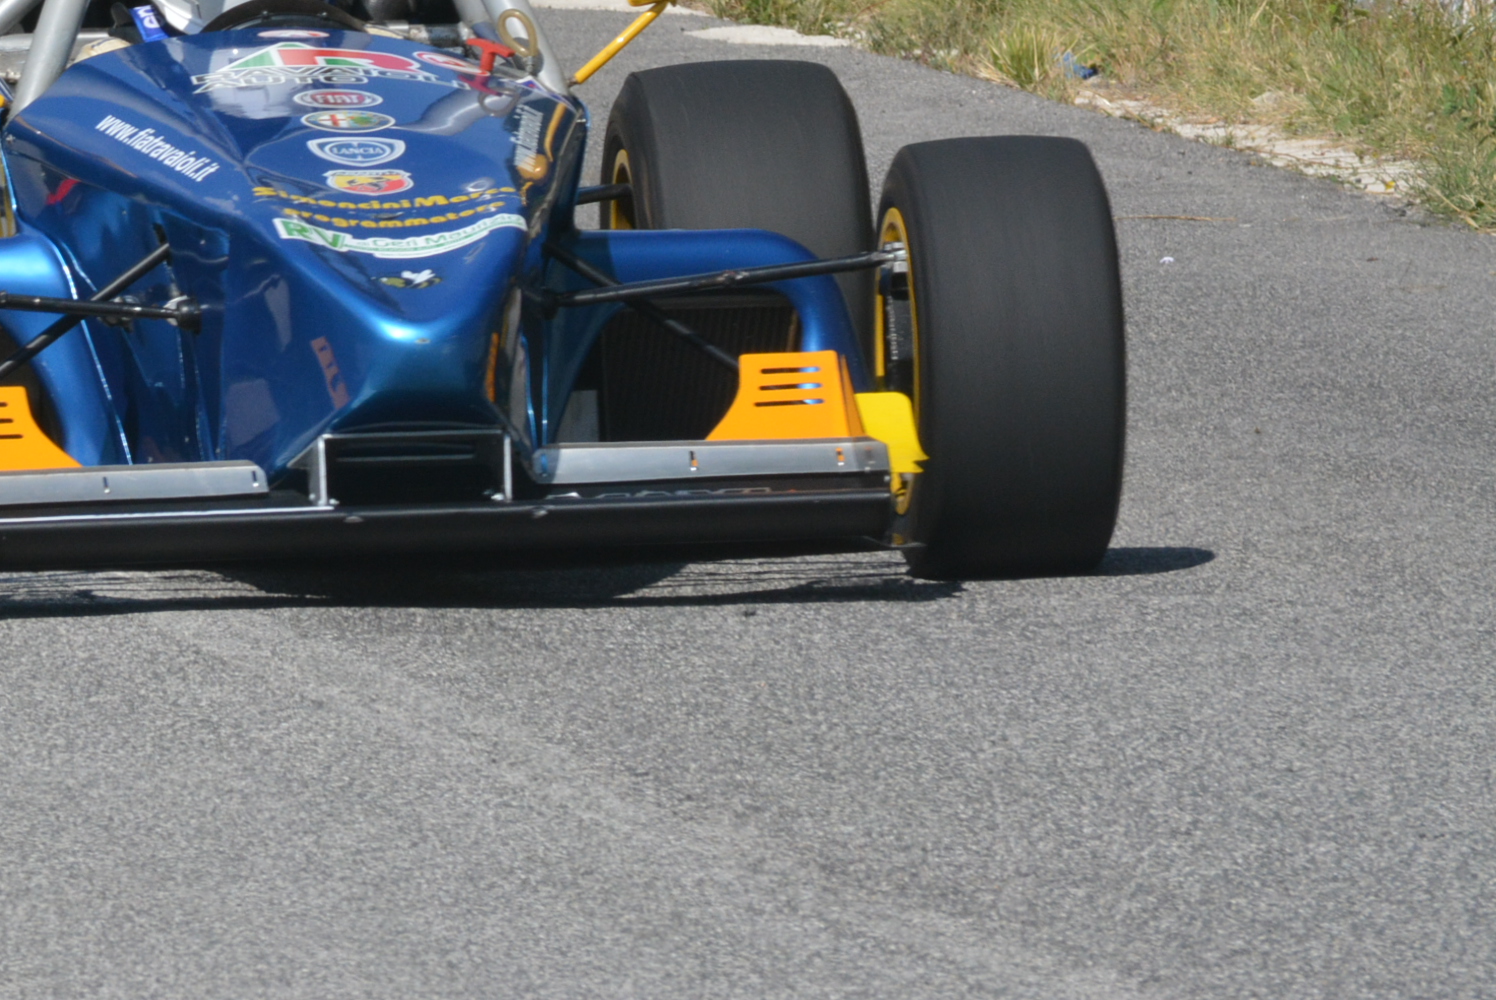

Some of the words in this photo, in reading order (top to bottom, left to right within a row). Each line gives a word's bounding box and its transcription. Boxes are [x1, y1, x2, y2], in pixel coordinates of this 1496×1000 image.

[315, 95, 360, 104] FIAT
[95, 114, 221, 182] www.fiatravaioli.it
[331, 147, 384, 155] LANCIA
